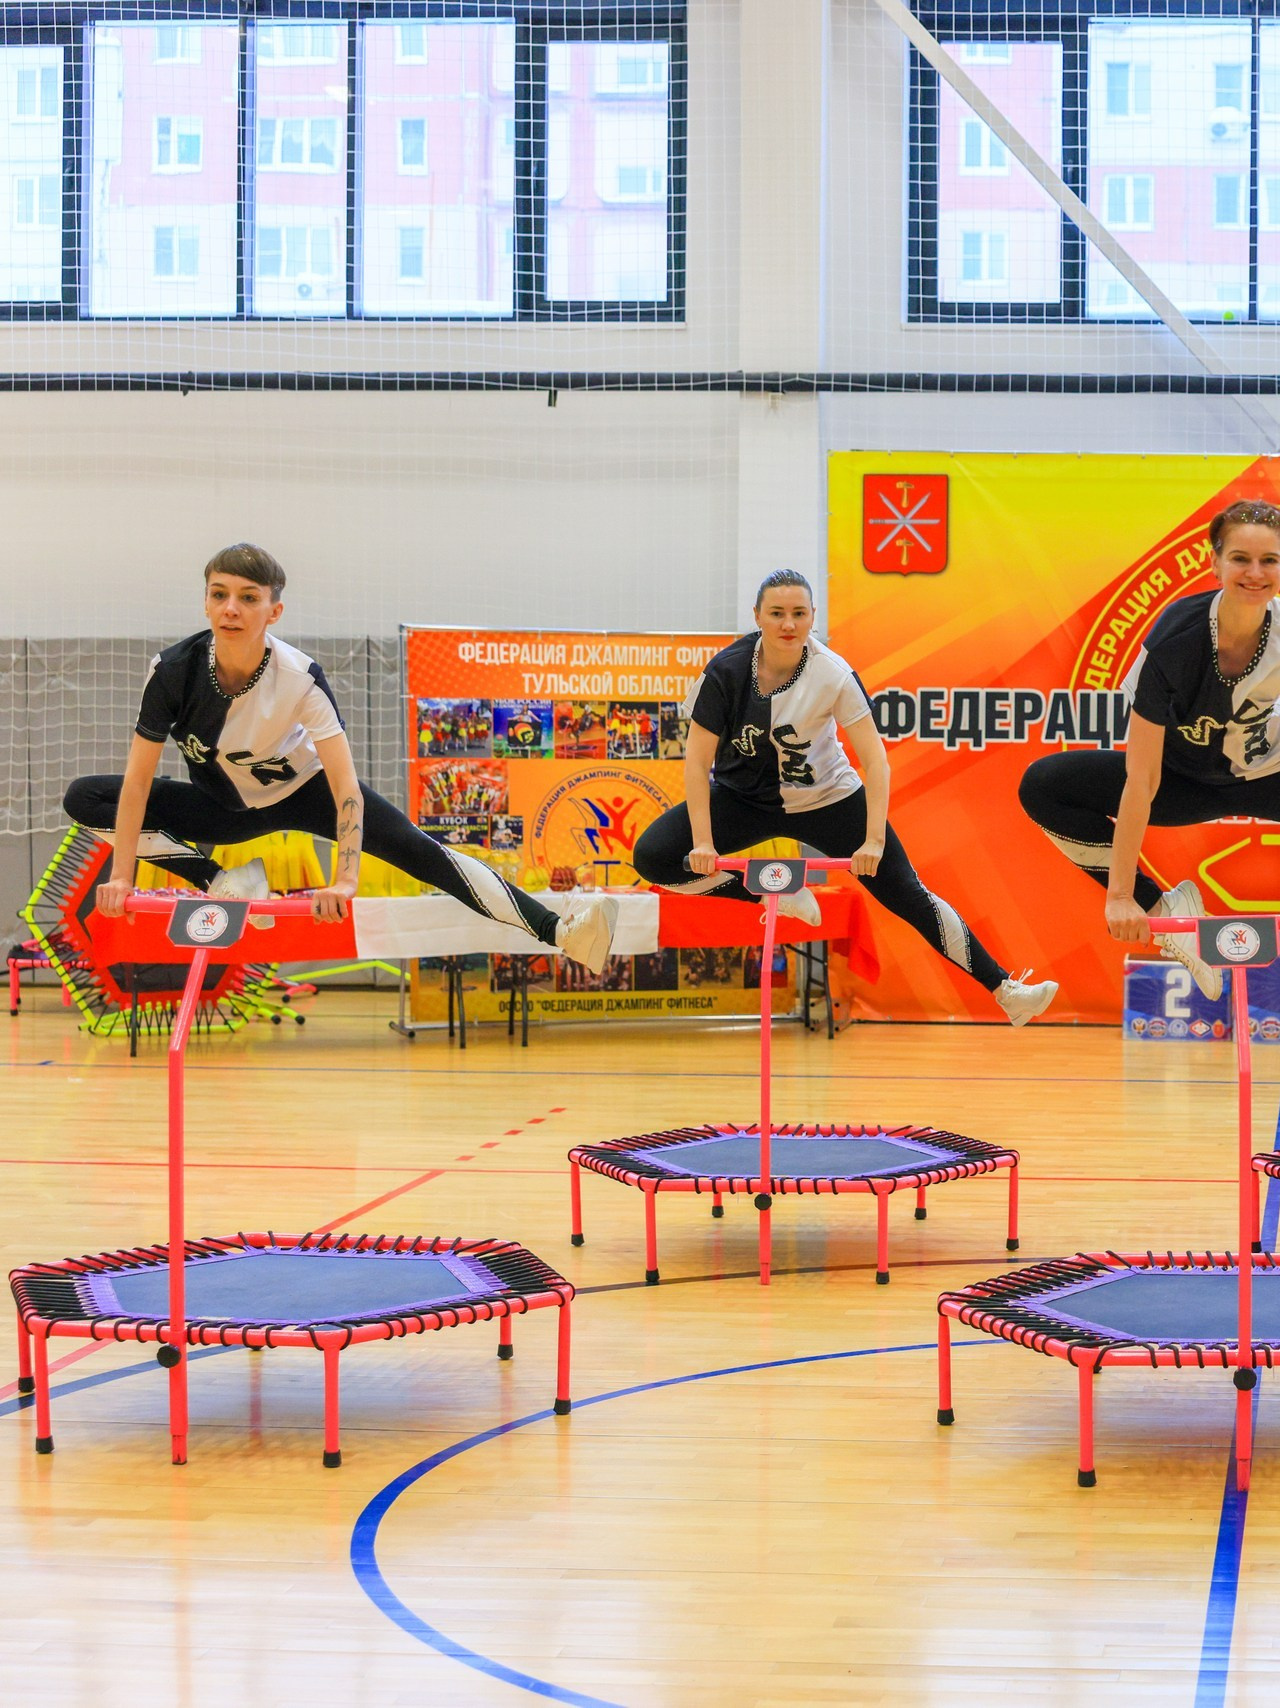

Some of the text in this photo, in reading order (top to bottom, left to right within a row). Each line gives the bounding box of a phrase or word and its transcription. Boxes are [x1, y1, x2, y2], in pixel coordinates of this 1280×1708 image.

[1084, 567, 1172, 690] ДЕРАЦИЯ
[458, 642, 567, 668] ФЕДЕРАЦИЯ
[570, 644, 669, 668] ДЖАМПИНГ
[522, 669, 696, 696] ТУЛЬСКОЙ ОБЛАСТИ
[872, 689, 1131, 750] ФЕДЕРАЦИ
[535, 770, 663, 839] ФЕДЕРАЦИЯ ДЖАМПИНГ ФИТНЕСА
[537, 998, 603, 1012] "ФЕДЕРАЦИЯ
[605, 998, 664, 1011] ДЖАМПИНГ
[667, 997, 718, 1009] ФИТНЕСА"
[1165, 968, 1191, 1018] 2
